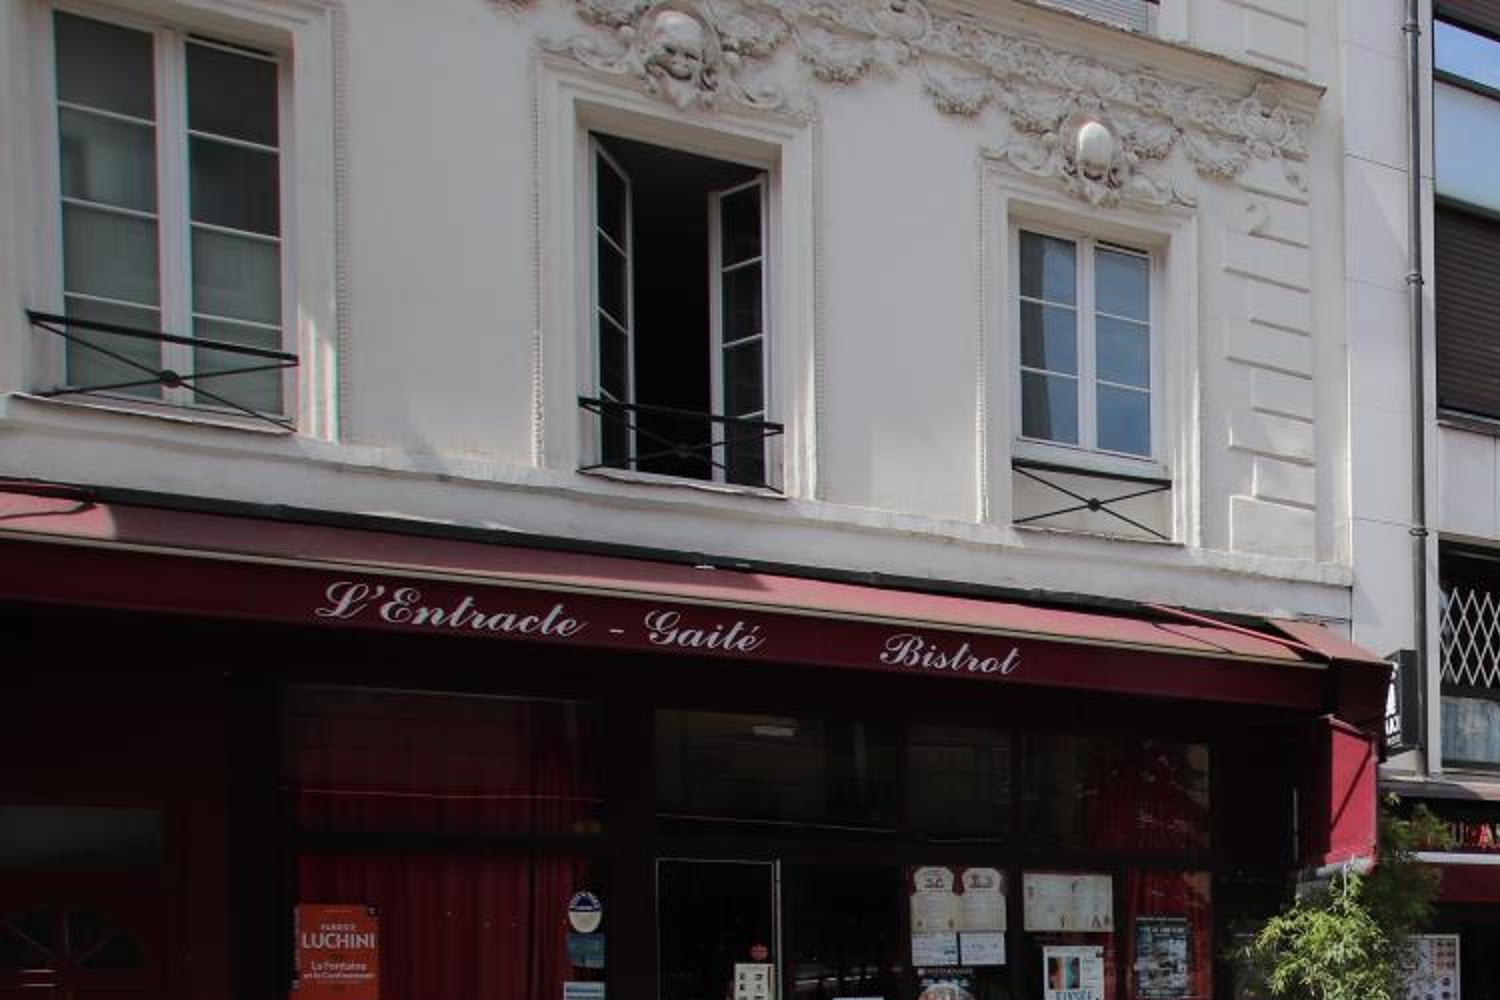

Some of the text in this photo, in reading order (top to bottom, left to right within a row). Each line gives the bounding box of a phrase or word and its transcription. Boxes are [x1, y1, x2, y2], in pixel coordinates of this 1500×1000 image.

[315, 580, 588, 638] L'Entracte
[643, 608, 767, 652] Gaité
[879, 632, 1022, 675] Bistrot
[302, 932, 375, 949] LUCHINI
